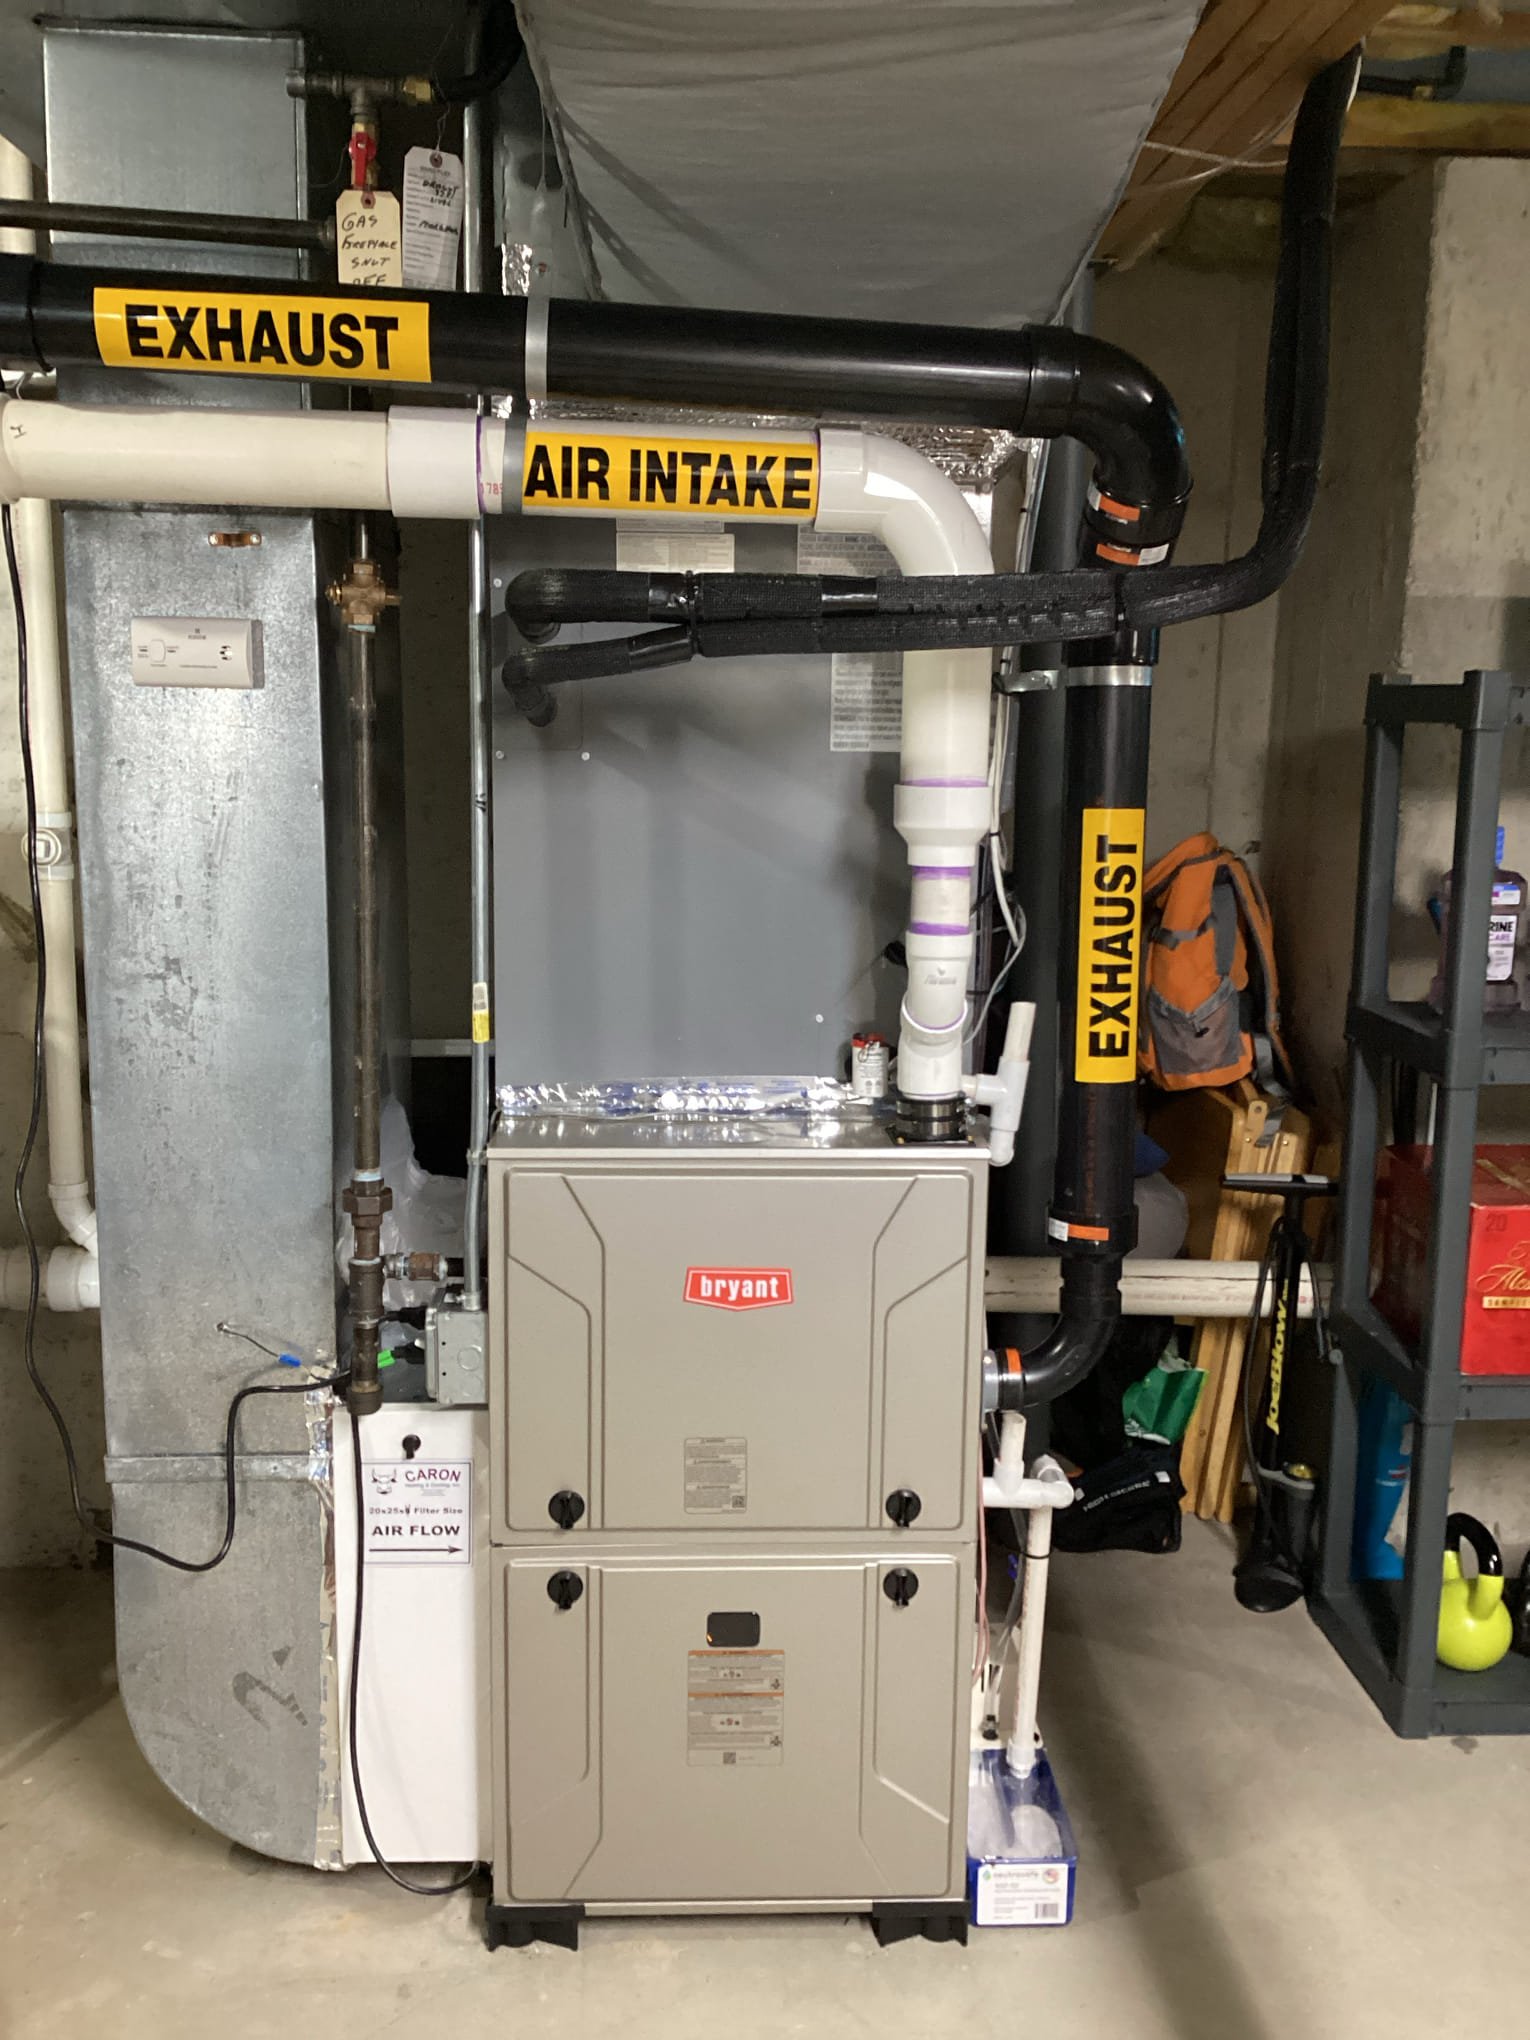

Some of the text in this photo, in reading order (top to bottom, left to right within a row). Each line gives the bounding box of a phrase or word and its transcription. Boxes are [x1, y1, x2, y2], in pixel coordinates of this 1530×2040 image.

[341, 212, 378, 232] GAS
[125, 304, 399, 370] EXHAUST
[524, 444, 813, 509] AIR INTAKE
[1088, 834, 1138, 1059] EXHAUST
[701, 1275, 779, 1302] bryant
[404, 1468, 461, 1483] CARON
[414, 1507, 440, 1515] Filter
[442, 1507, 463, 1515] Size
[371, 1525, 461, 1536] AIR FLOW
